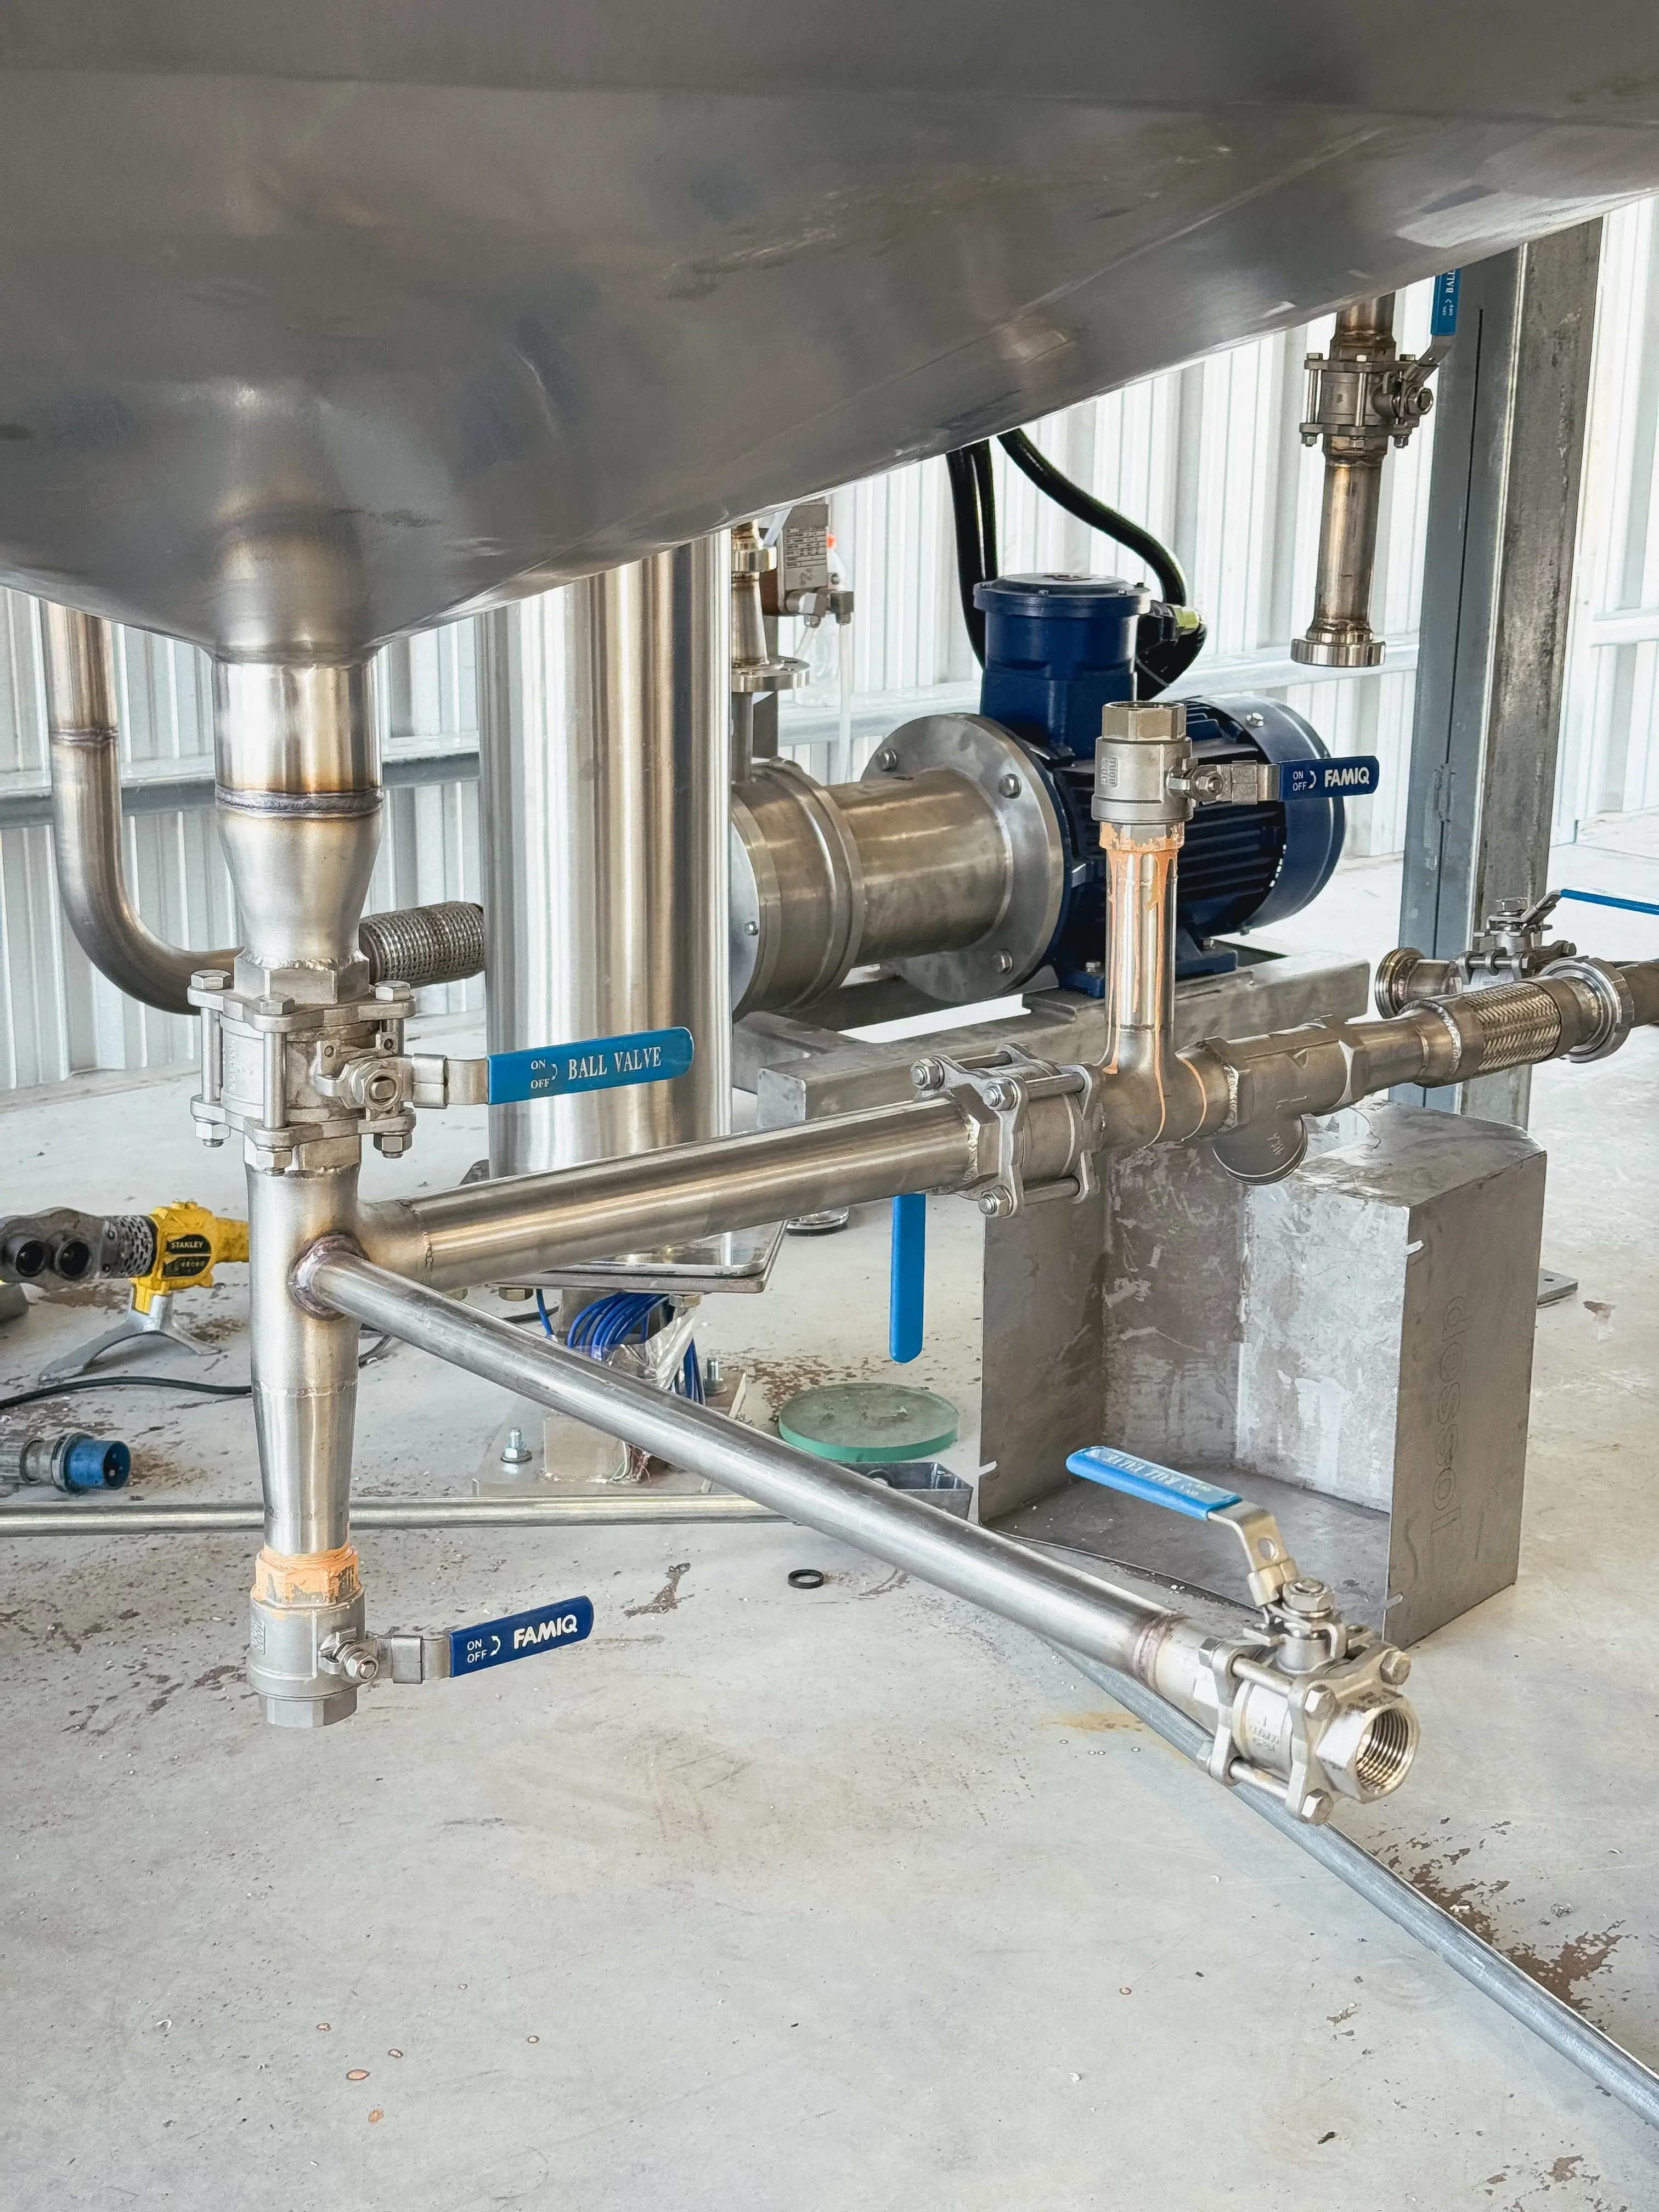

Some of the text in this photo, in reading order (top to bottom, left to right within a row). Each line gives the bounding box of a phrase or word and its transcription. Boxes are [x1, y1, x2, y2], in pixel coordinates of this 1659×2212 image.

[1293, 771, 1304, 780] ON
[1324, 767, 1370, 788] FAMIQ
[1293, 781, 1307, 791] OFF
[531, 1059, 546, 1070] ON
[568, 1046, 662, 1080] BALL VALVE
[531, 1077, 550, 1090] OFF
[171, 1240, 204, 1249] STANLEY
[514, 1614, 578, 1650] FAMIQ
[467, 1638, 482, 1651] ON
[467, 1649, 488, 1663] OFF
